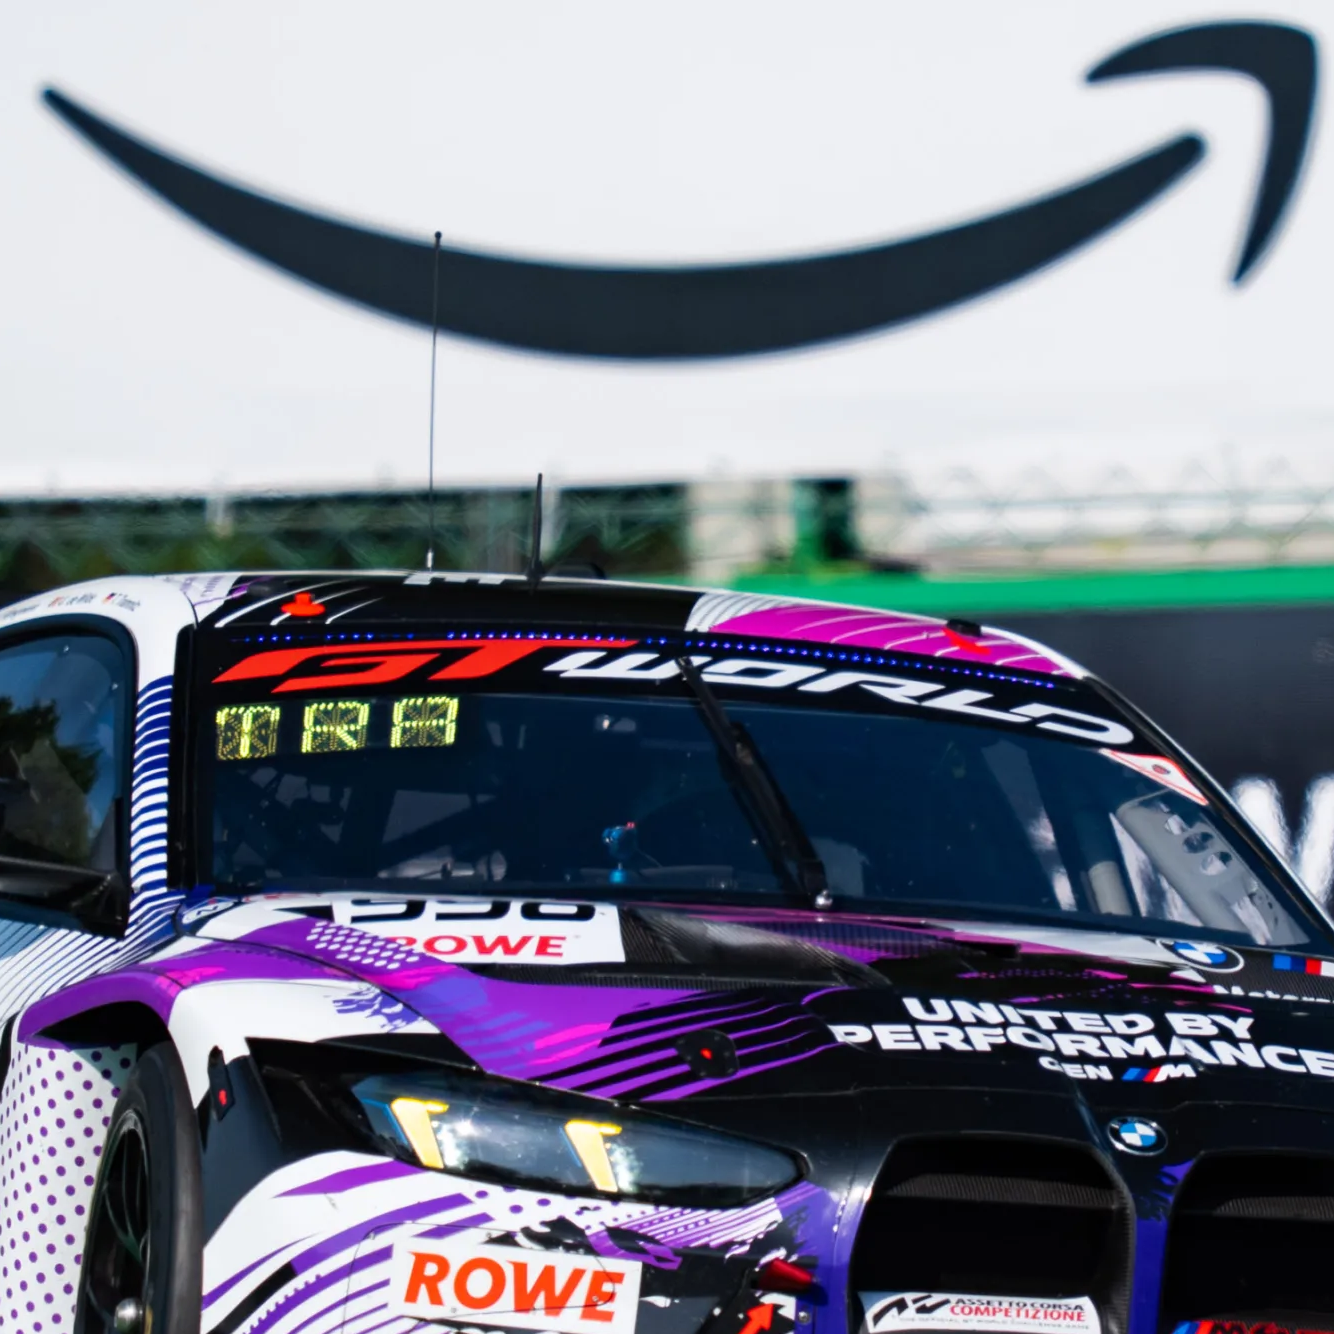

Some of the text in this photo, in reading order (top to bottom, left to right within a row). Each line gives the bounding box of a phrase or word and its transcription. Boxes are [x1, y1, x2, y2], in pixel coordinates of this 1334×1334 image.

[212, 639, 1135, 745] GT WORLD
[902, 998, 1255, 1040] UNITED BY
[1038, 1056, 1114, 1081] GEN
[403, 1251, 624, 1323] ROWE
[949, 1305, 1087, 1323] COMPETIZIONE
[954, 1297, 1085, 1312] ASSETTO CORSA
